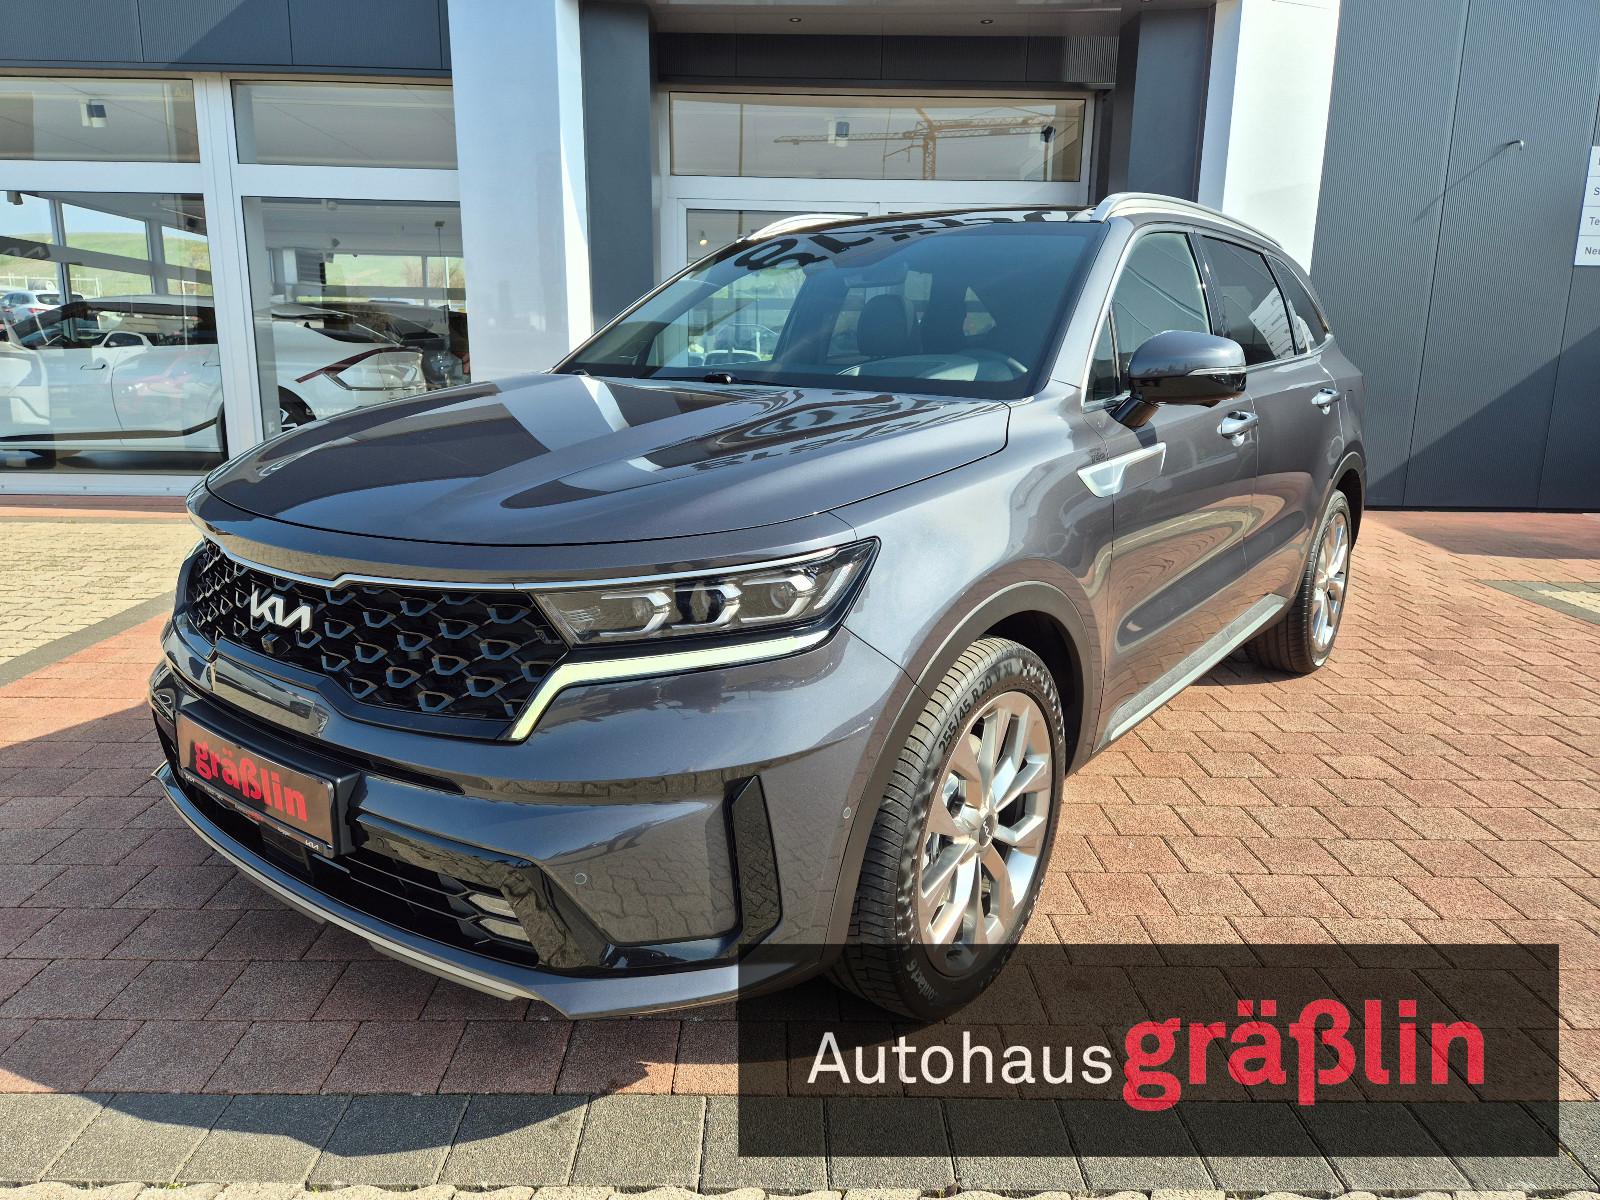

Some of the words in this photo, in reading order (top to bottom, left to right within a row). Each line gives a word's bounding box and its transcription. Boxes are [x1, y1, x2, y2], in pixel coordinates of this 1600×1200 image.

[250, 589, 313, 633] KIA
[938, 698, 971, 753] 255/45
[979, 675, 993, 693] 20
[194, 741, 308, 822] gräßlin
